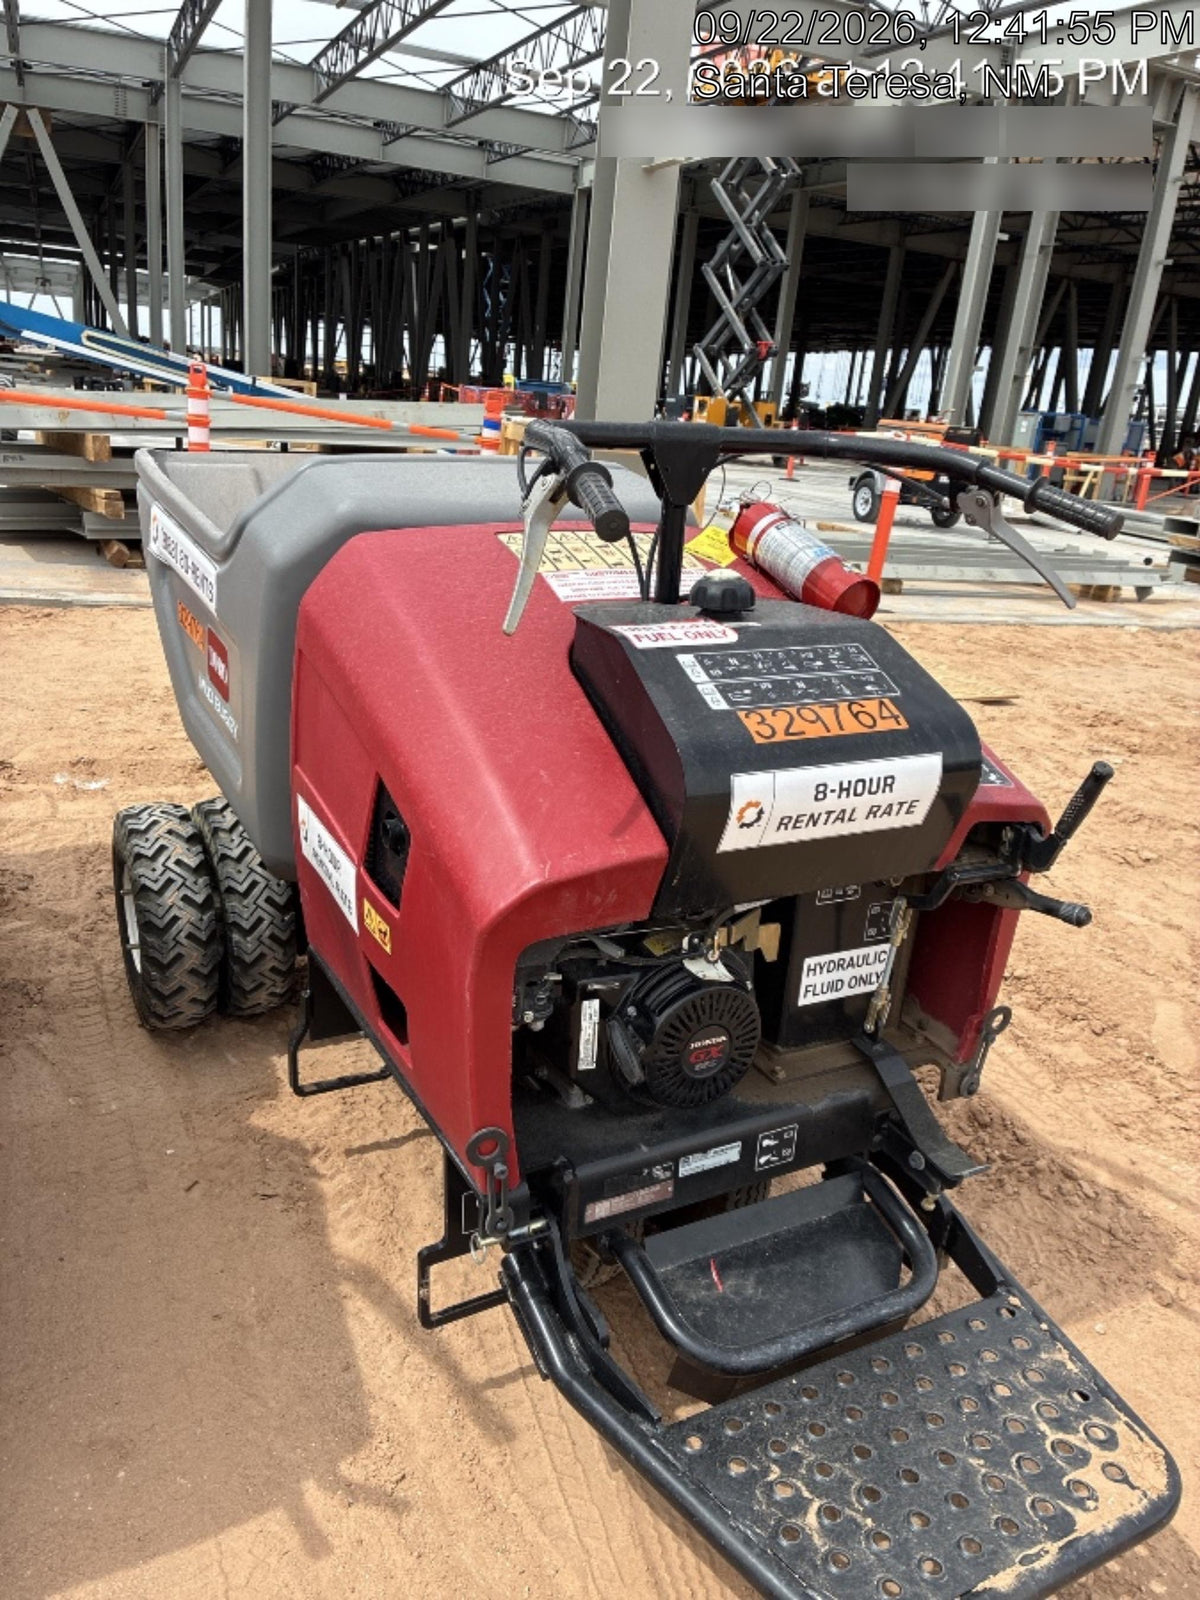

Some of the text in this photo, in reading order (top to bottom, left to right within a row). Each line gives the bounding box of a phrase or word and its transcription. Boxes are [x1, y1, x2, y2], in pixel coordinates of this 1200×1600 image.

[633, 628, 729, 643] FUEL ONLY
[744, 700, 902, 740] 329764
[813, 774, 896, 802] 8-HOUR
[775, 799, 920, 832] RENTAL RATE
[806, 950, 888, 978] HYDRAULIC
[803, 971, 886, 999] FLUID ONLY
